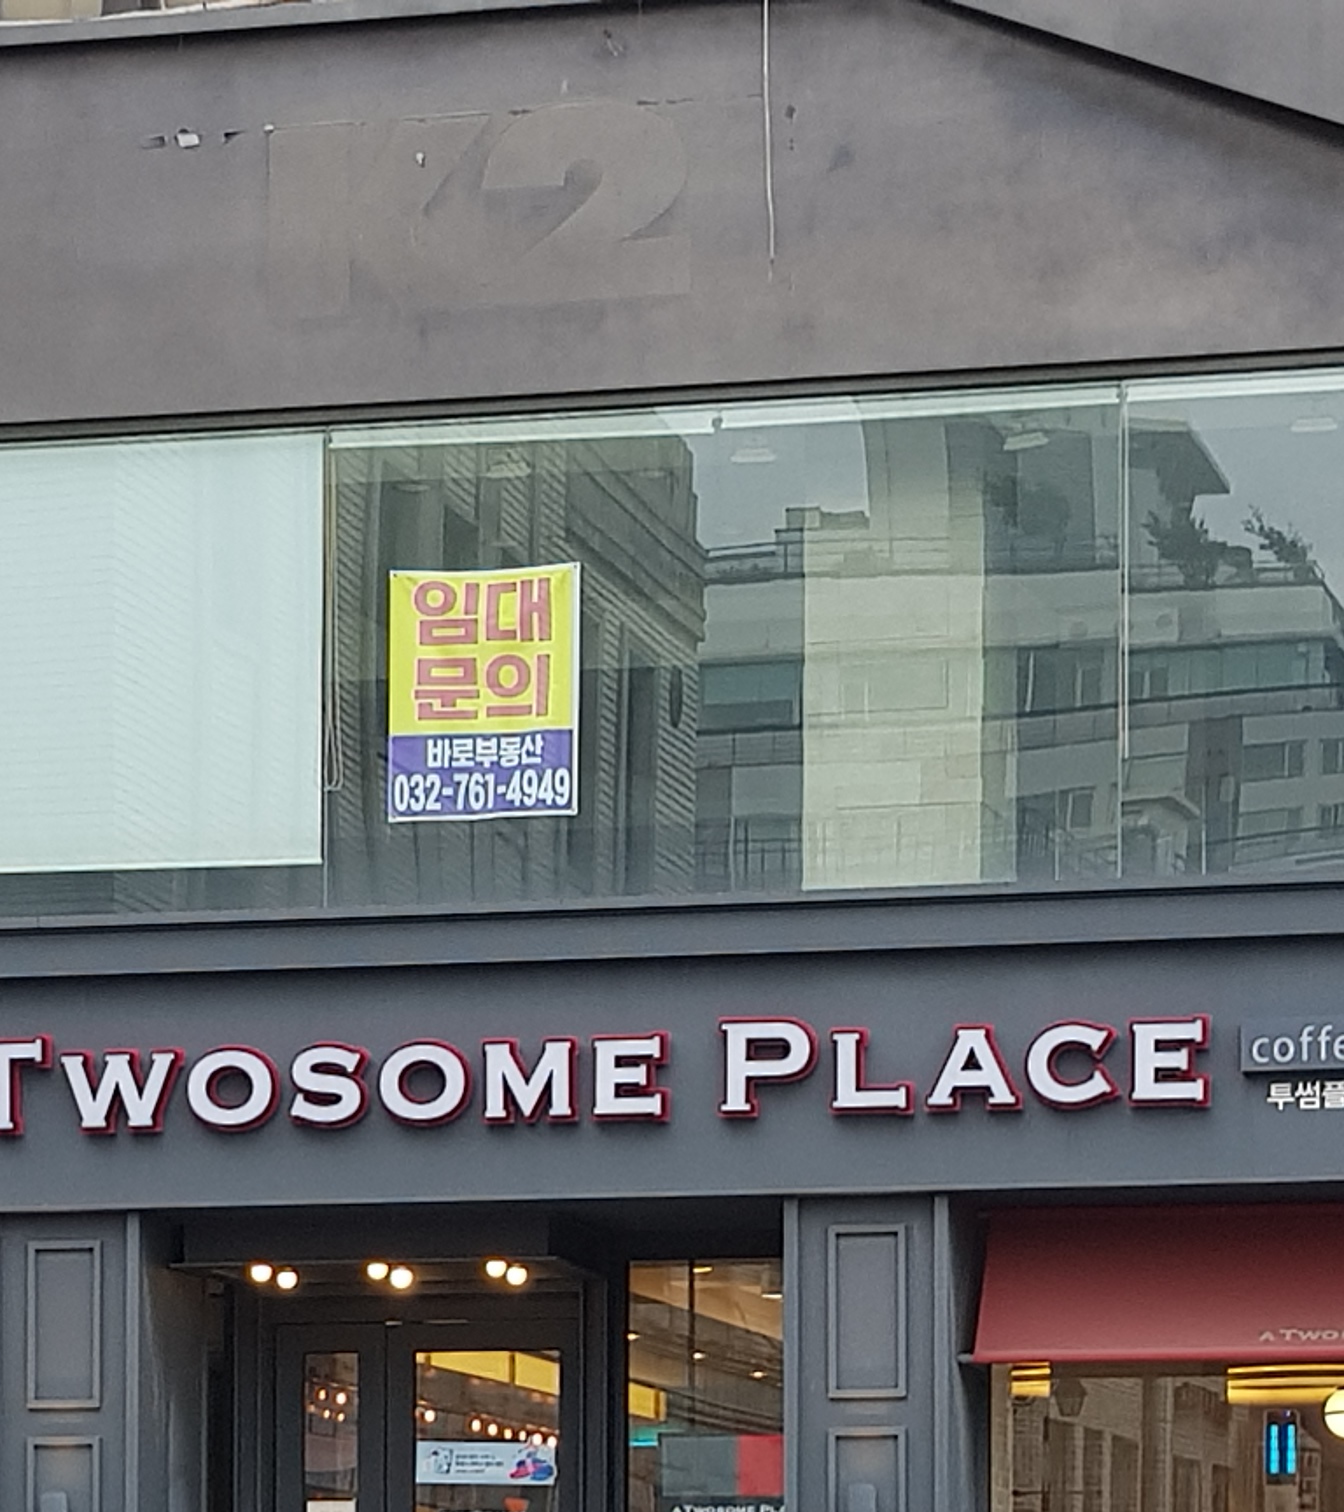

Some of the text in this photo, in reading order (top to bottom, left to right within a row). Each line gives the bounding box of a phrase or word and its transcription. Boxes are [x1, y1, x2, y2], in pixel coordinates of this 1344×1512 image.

[413, 577, 552, 647] 임대
[413, 653, 552, 722] 문의
[426, 735, 544, 768] 바로부동산
[393, 768, 571, 812] 032-761-4949
[717, 1013, 1214, 1117] PLACE
